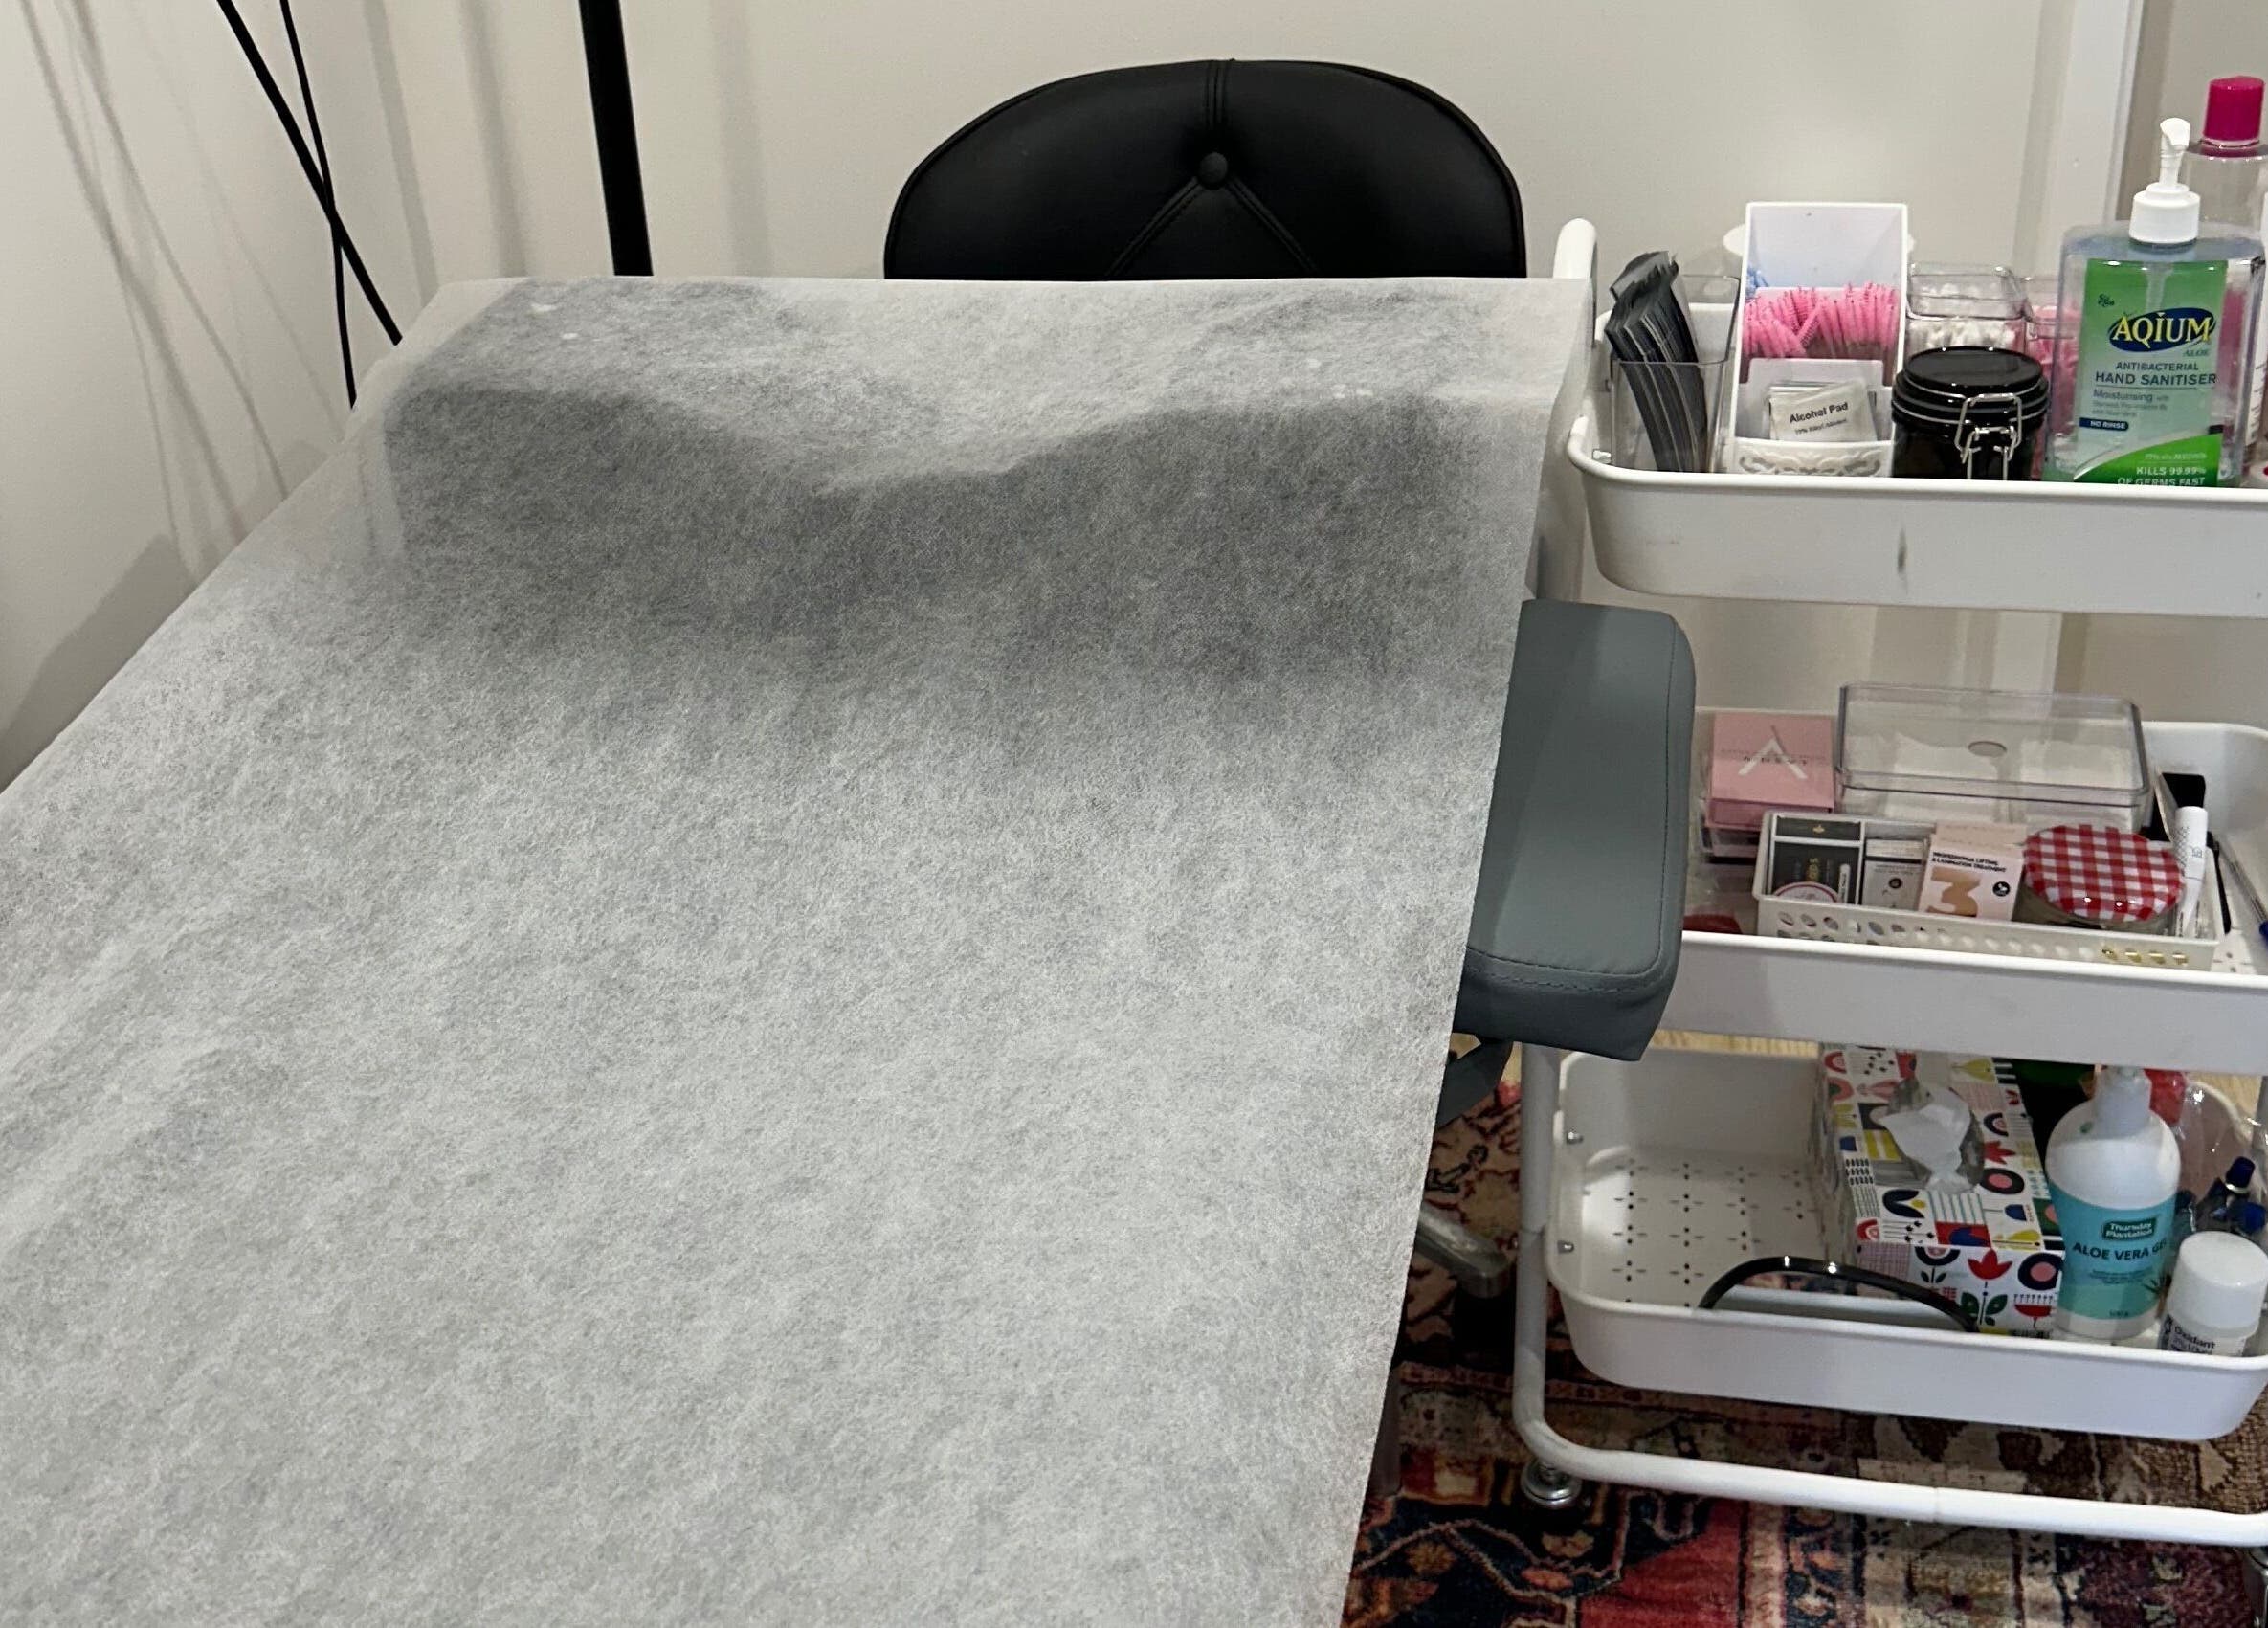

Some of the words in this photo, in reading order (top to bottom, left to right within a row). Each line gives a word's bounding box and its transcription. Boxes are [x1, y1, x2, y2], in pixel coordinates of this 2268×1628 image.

[2112, 312, 2212, 349] AQIUM
[2116, 362, 2199, 371] ANTIBACTERIAL
[2095, 371, 2136, 384] HAND
[2140, 373, 2216, 385] SANITISER
[1790, 407, 1827, 423] Alcohol
[1829, 401, 1848, 413] Pad
[2102, 421, 2126, 430] RINSE
[2136, 466, 2167, 475] KILLS
[2117, 478, 2134, 486] OF
[2135, 478, 2177, 486] GERMS
[2179, 477, 2206, 486] FAST
[2110, 1223, 2152, 1232] Thursday
[2105, 1229, 2153, 1238] Plantation
[2073, 1242, 2109, 1259] ALOE
[2114, 1247, 2149, 1260] VERA
